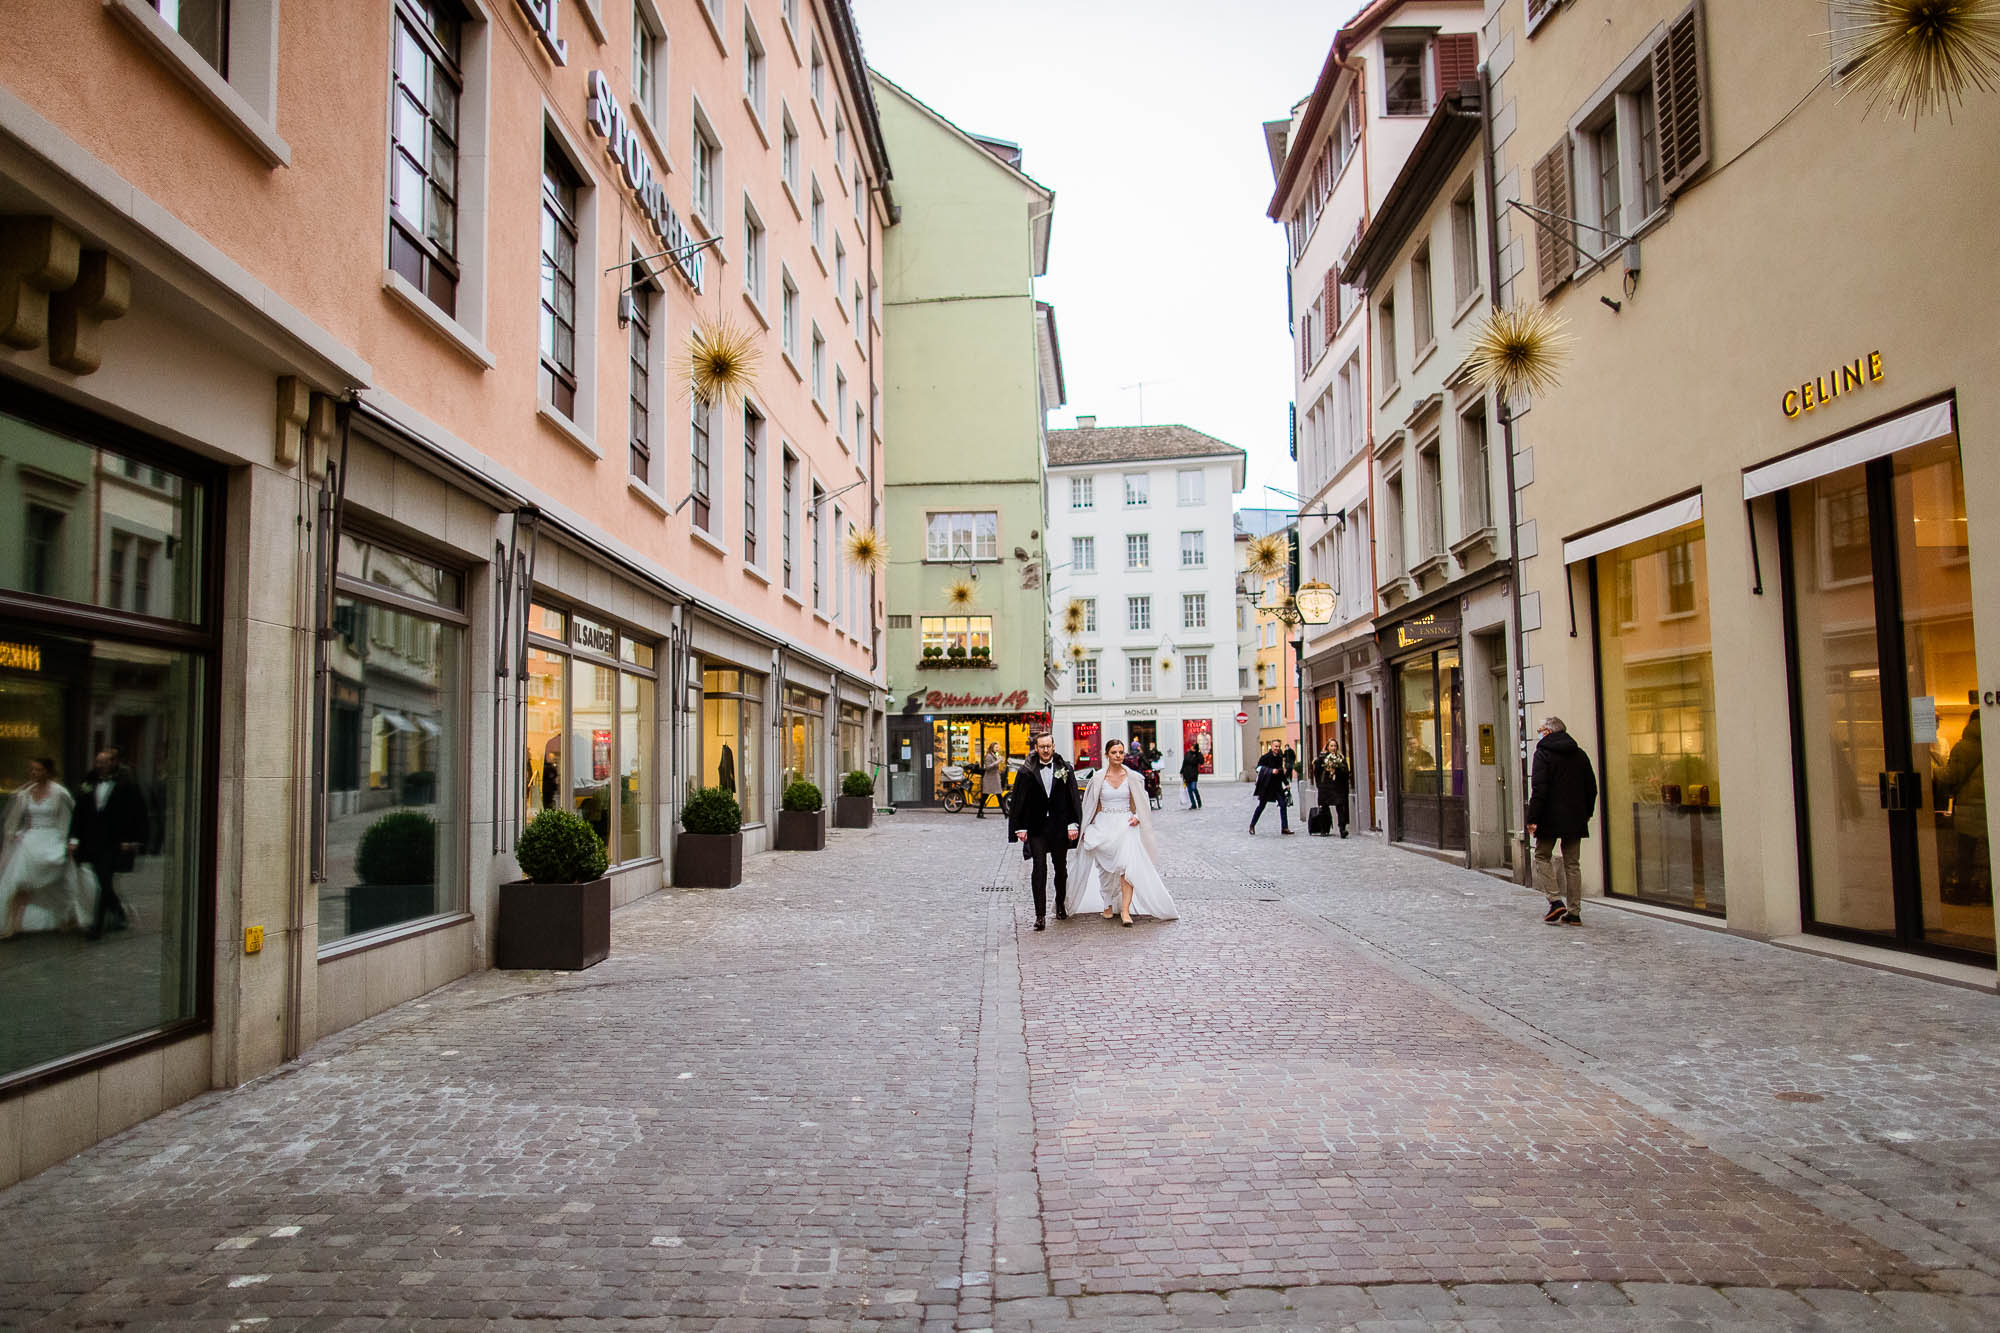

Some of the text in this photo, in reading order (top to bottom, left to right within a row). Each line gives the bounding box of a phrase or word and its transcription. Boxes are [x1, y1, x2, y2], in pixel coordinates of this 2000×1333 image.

[588, 69, 706, 297] STORCHEN
[1781, 349, 1885, 418] CELINE
[583, 625, 614, 654] SANDER
[1003, 689, 1029, 710] AG
[1124, 708, 1158, 716] MONCLER
